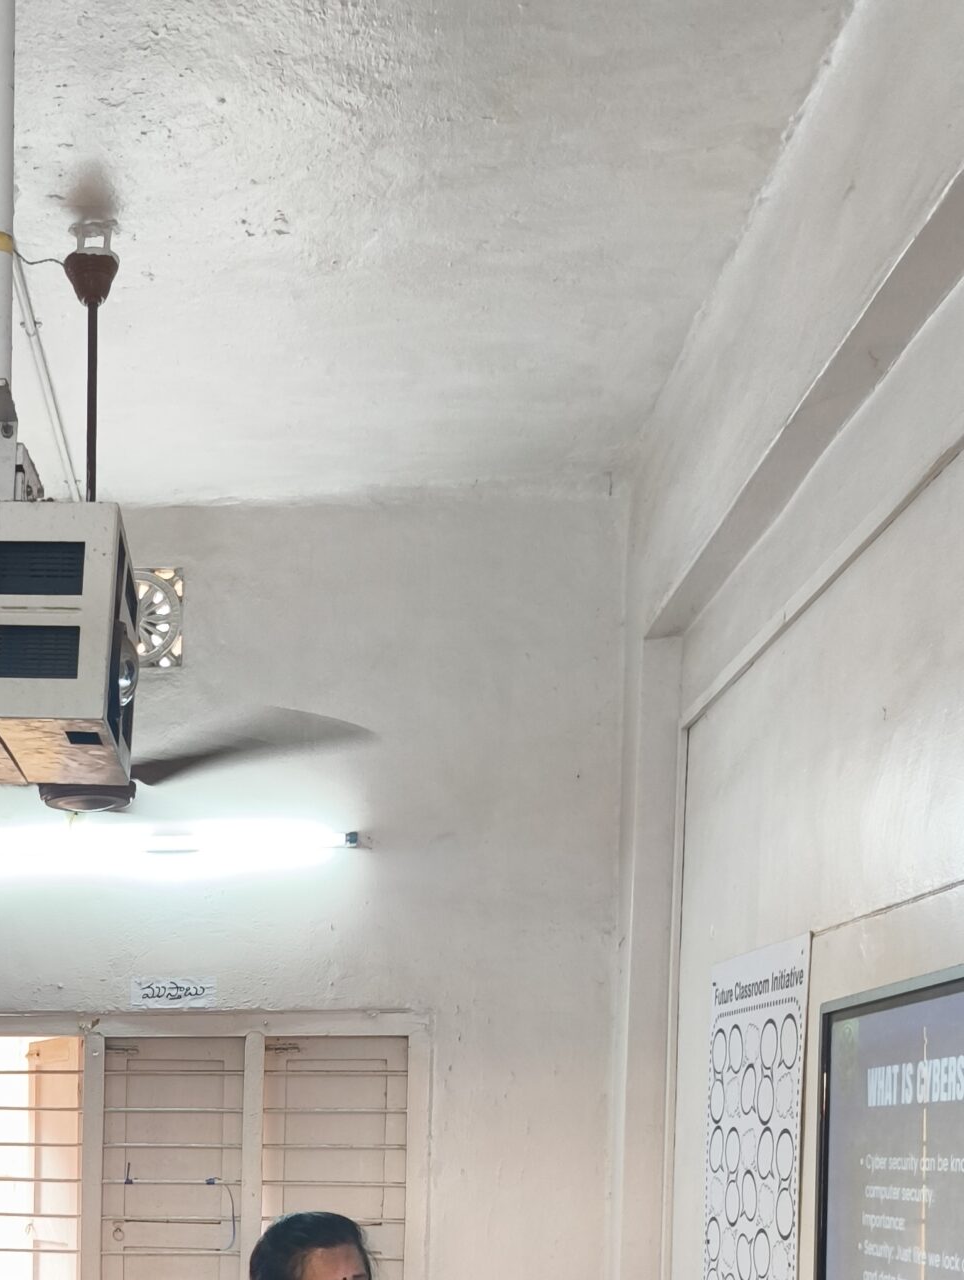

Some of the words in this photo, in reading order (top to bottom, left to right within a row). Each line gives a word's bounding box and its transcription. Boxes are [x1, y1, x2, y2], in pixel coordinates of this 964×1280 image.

[715, 988, 733, 1006] Future
[734, 979, 770, 1001] Classroom
[771, 966, 804, 992] Initiative
[867, 1064, 899, 1107] WHAT
[901, 1062, 914, 1104] IS
[916, 1054, 964, 1104] CYBERS
[865, 1153, 887, 1175] Cyber
[888, 1152, 918, 1176] security
[919, 1157, 936, 1171] can
[937, 1153, 949, 1172] be
[865, 1185, 900, 1205] computer
[895, 1245, 912, 1263] Just
[928, 1252, 941, 1268] we
[942, 1250, 960, 1271] lock
